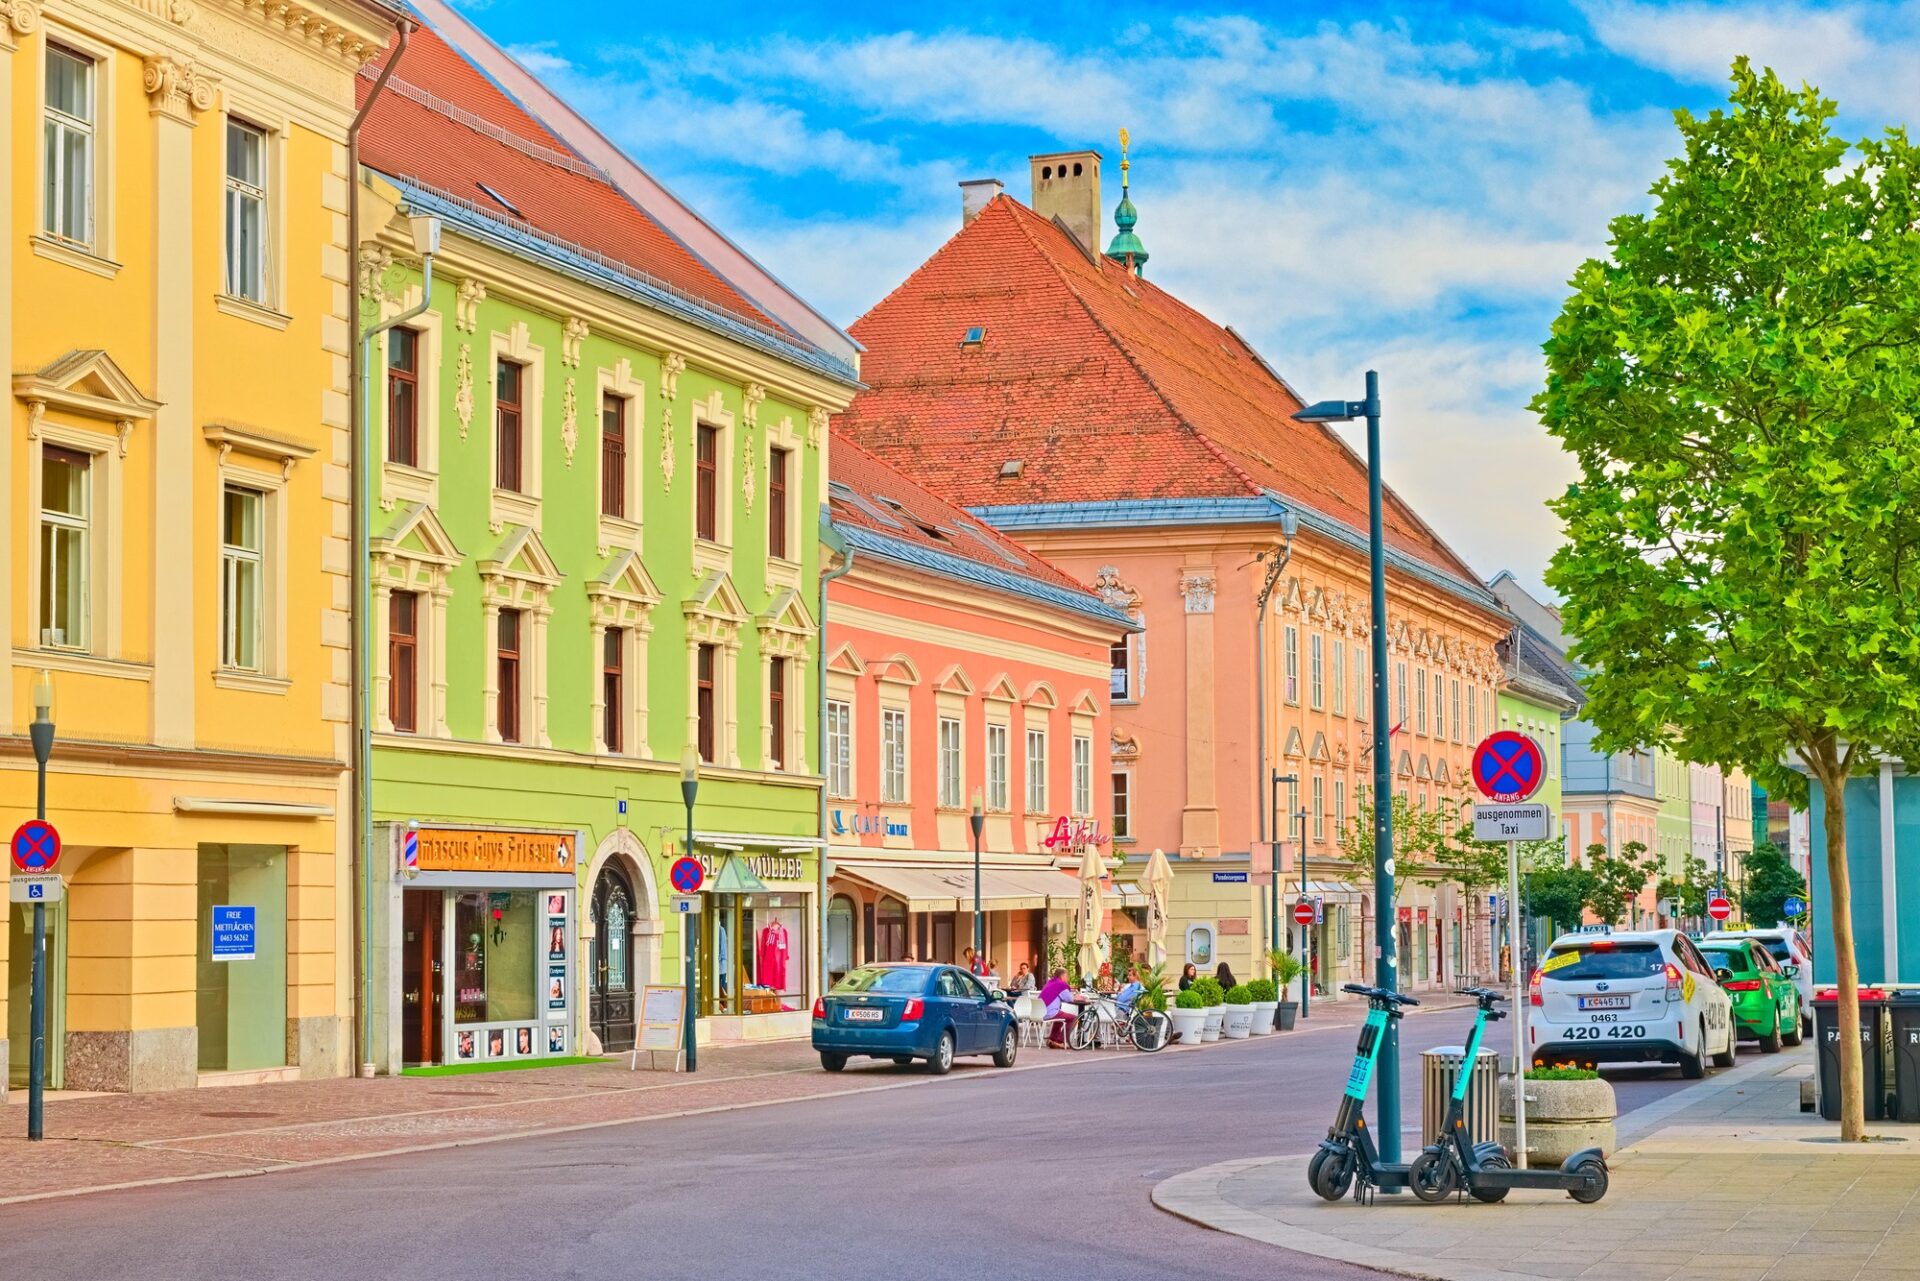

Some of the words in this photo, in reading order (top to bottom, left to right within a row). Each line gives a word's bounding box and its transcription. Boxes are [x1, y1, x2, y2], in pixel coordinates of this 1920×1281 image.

[1493, 792, 1520, 802] ANFANG
[1477, 809, 1542, 822] ausgenommen
[1501, 823, 1519, 835] Taxi
[417, 837, 469, 862] mascus
[13, 876, 58, 884] ausgenommen
[226, 911, 242, 919] FREIE
[1650, 963, 1663, 971] 17
[1591, 1014, 1618, 1023] 0463
[1562, 1027, 1600, 1040] 420
[1607, 1025, 1646, 1039] 420
[1910, 1032, 1920, 1044] R
